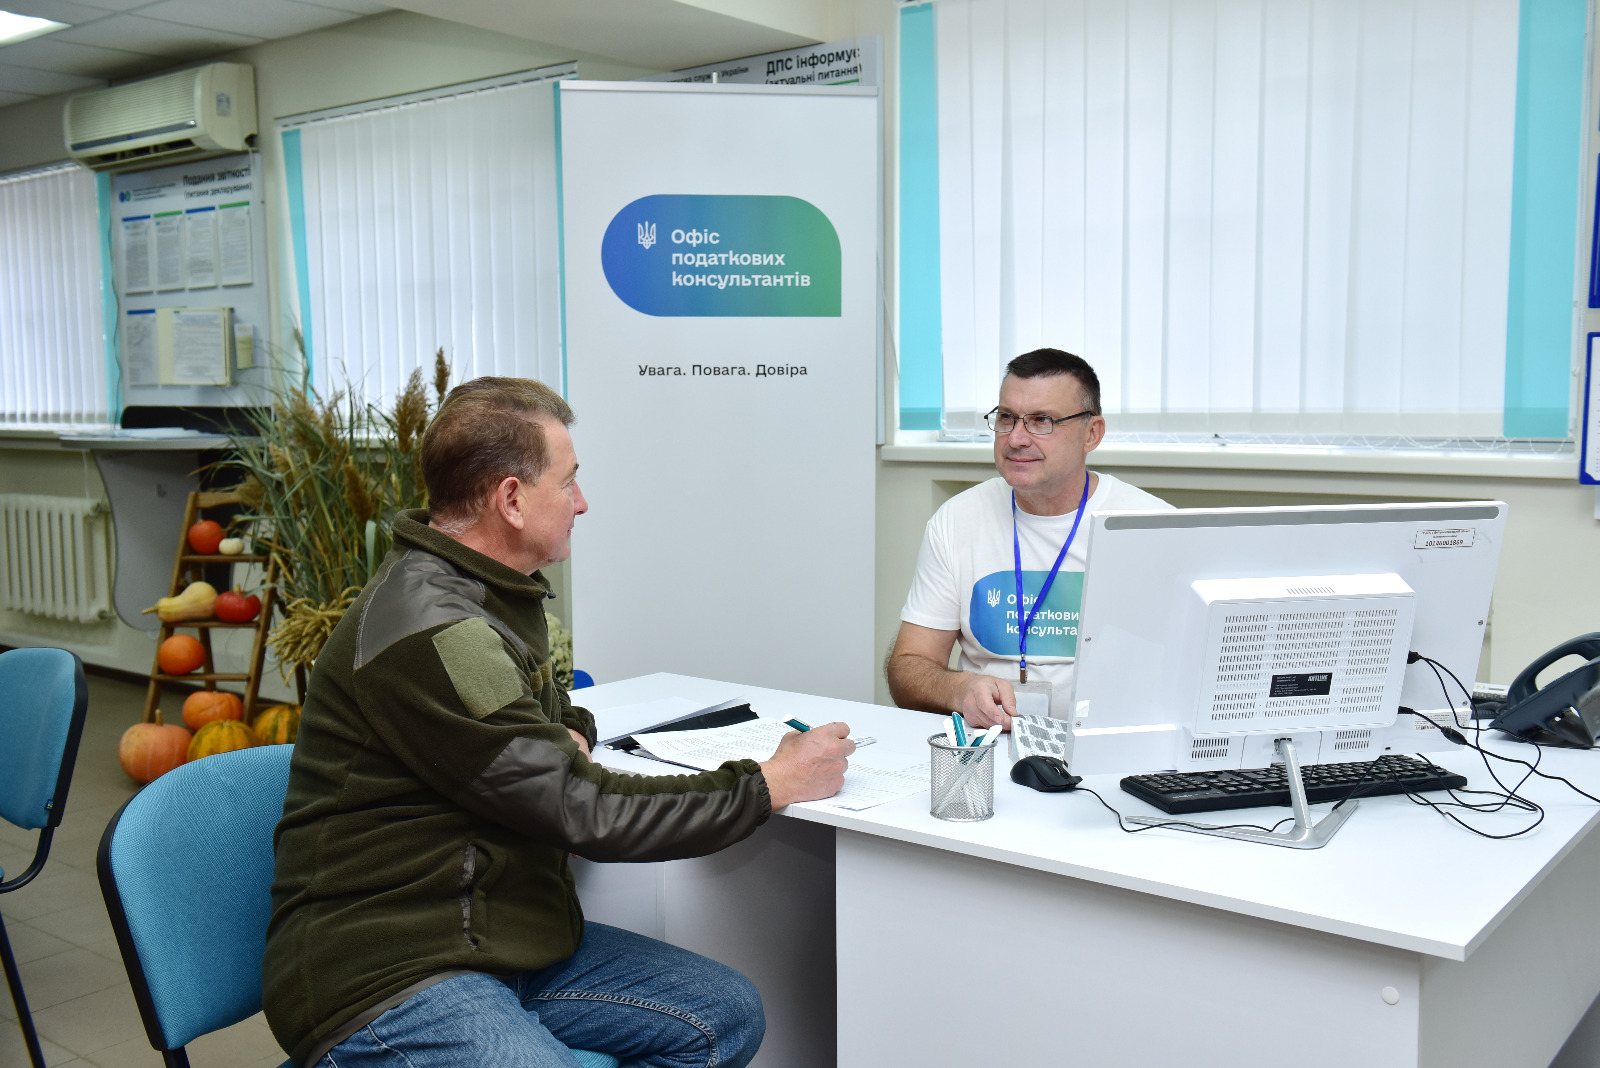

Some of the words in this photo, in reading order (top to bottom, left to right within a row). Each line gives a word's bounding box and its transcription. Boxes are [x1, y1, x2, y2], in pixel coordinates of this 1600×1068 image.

[766, 57, 793, 77] ДПС
[817, 64, 862, 81] питання)
[694, 72, 719, 83] служ
[182, 173, 215, 186] Подання
[216, 164, 252, 181] звітності
[671, 229, 720, 247] Офіс
[671, 250, 786, 267] податкових
[671, 271, 811, 290] консультантів
[638, 364, 687, 377] Увага.
[692, 364, 751, 377] Повага.
[755, 363, 808, 378] Довіра
